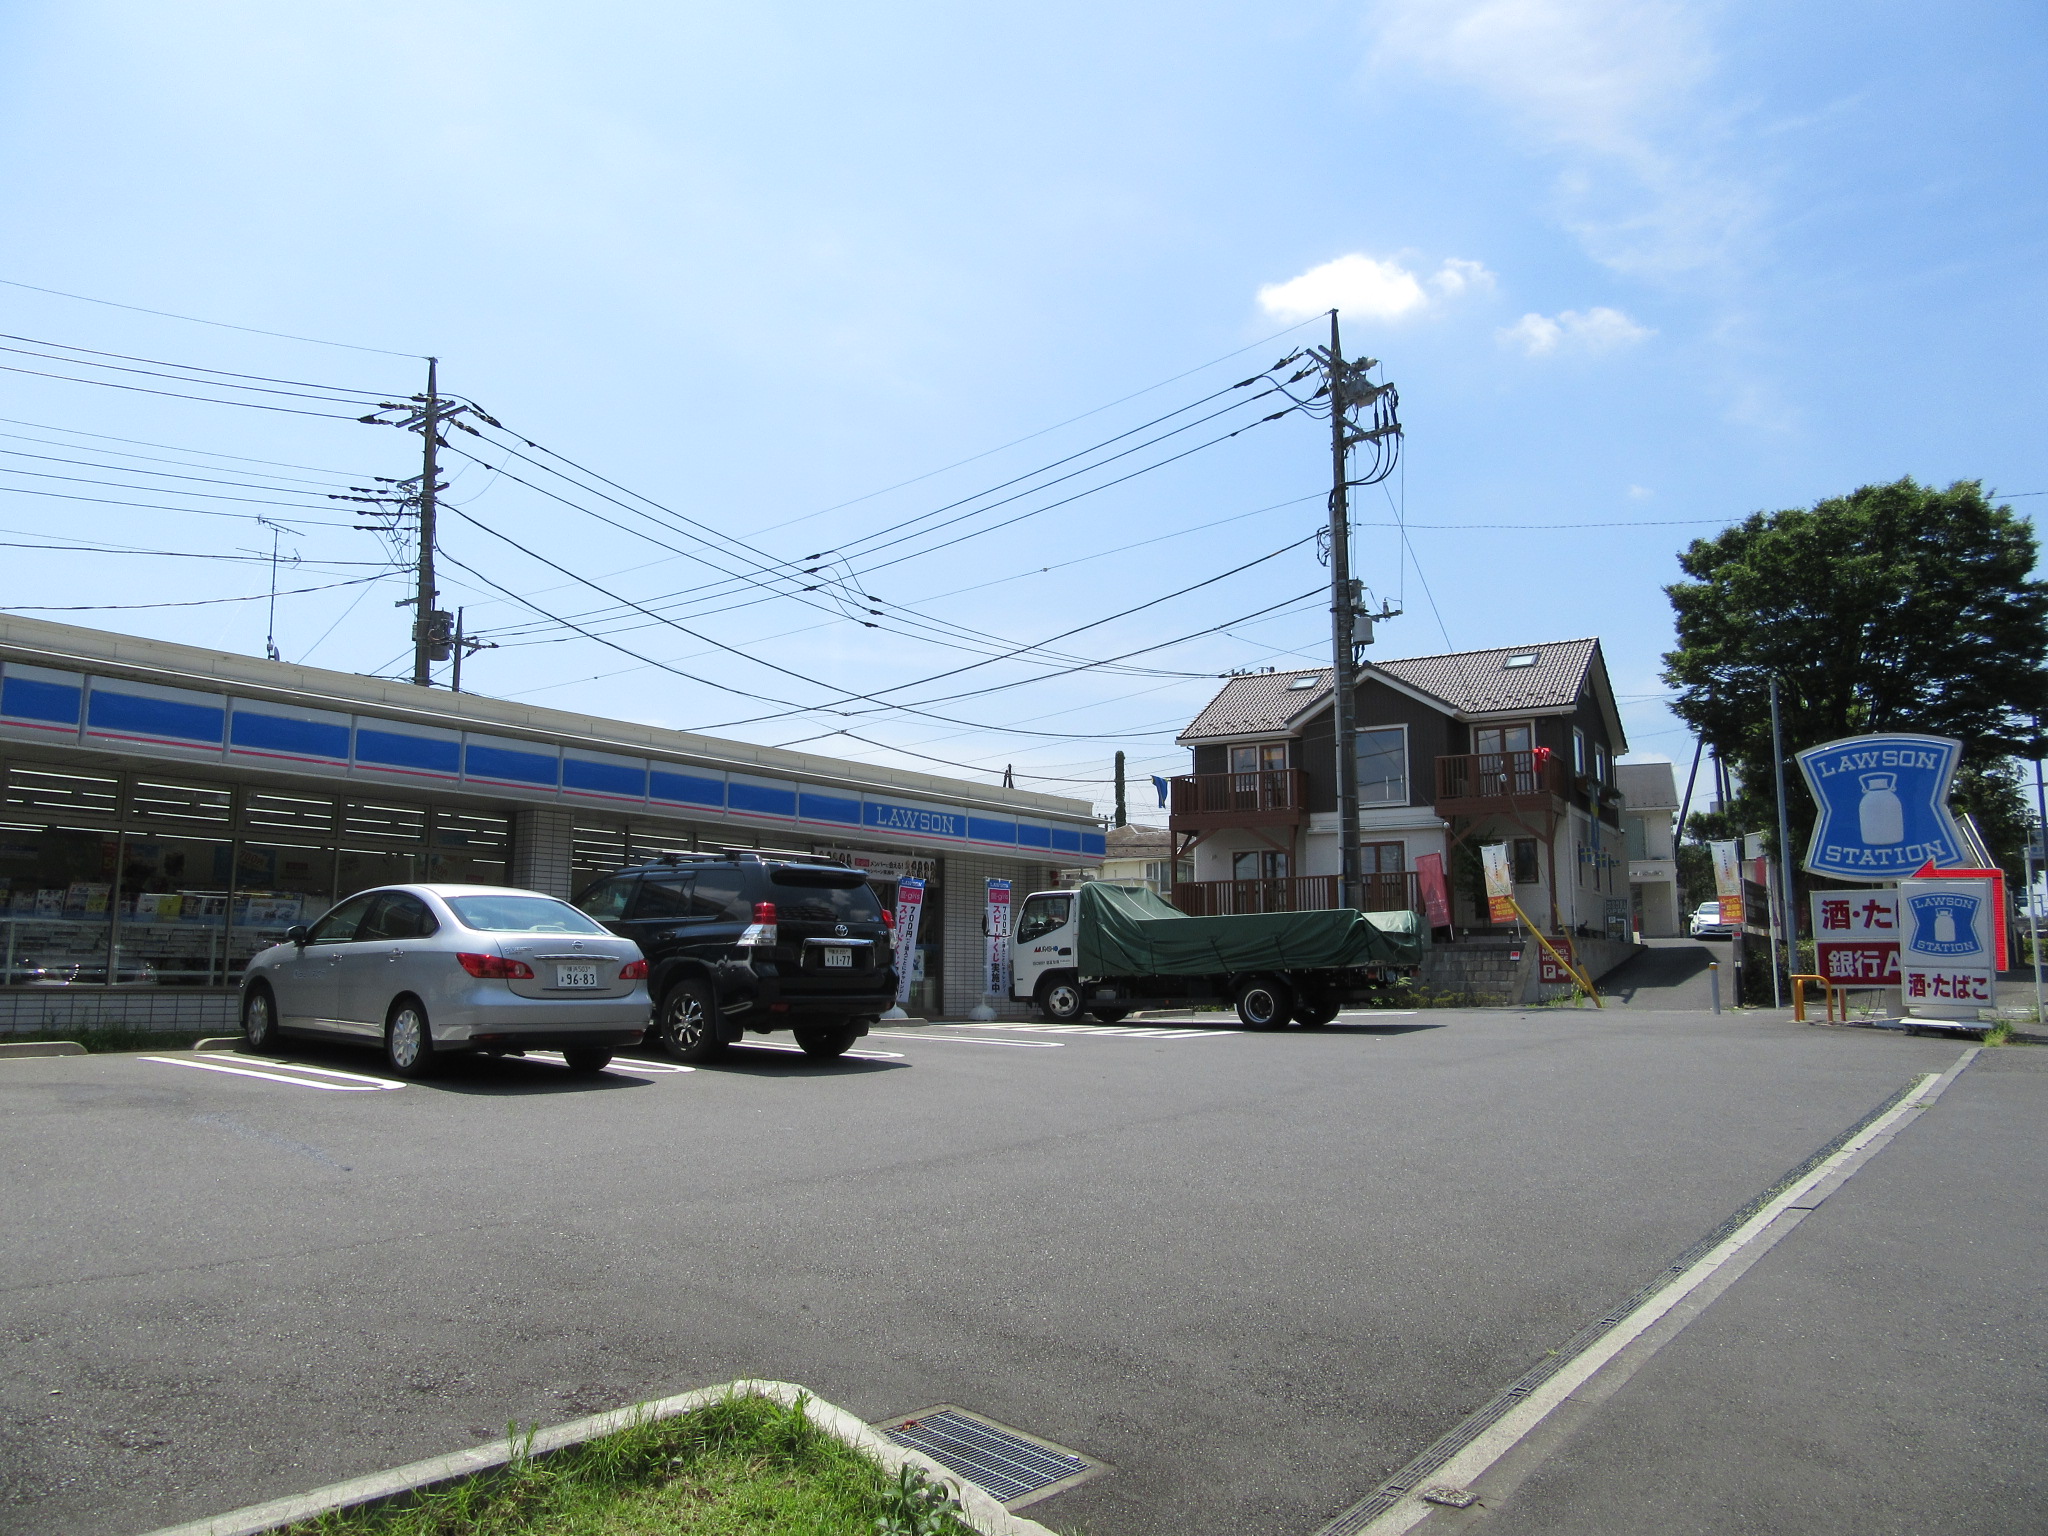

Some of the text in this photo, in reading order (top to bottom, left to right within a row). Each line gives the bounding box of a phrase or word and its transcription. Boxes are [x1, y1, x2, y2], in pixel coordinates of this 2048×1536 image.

[1818, 750, 1938, 778] LAWSON
[876, 806, 955, 834] LAWSON
[1825, 840, 1946, 866] STATION
[1821, 899, 1900, 931] 酒・た
[1914, 898, 1975, 909] LAWSON
[1917, 940, 1975, 953] STATION
[1545, 966, 1554, 977] P
[1908, 972, 1988, 1000] 酒・たばこ
